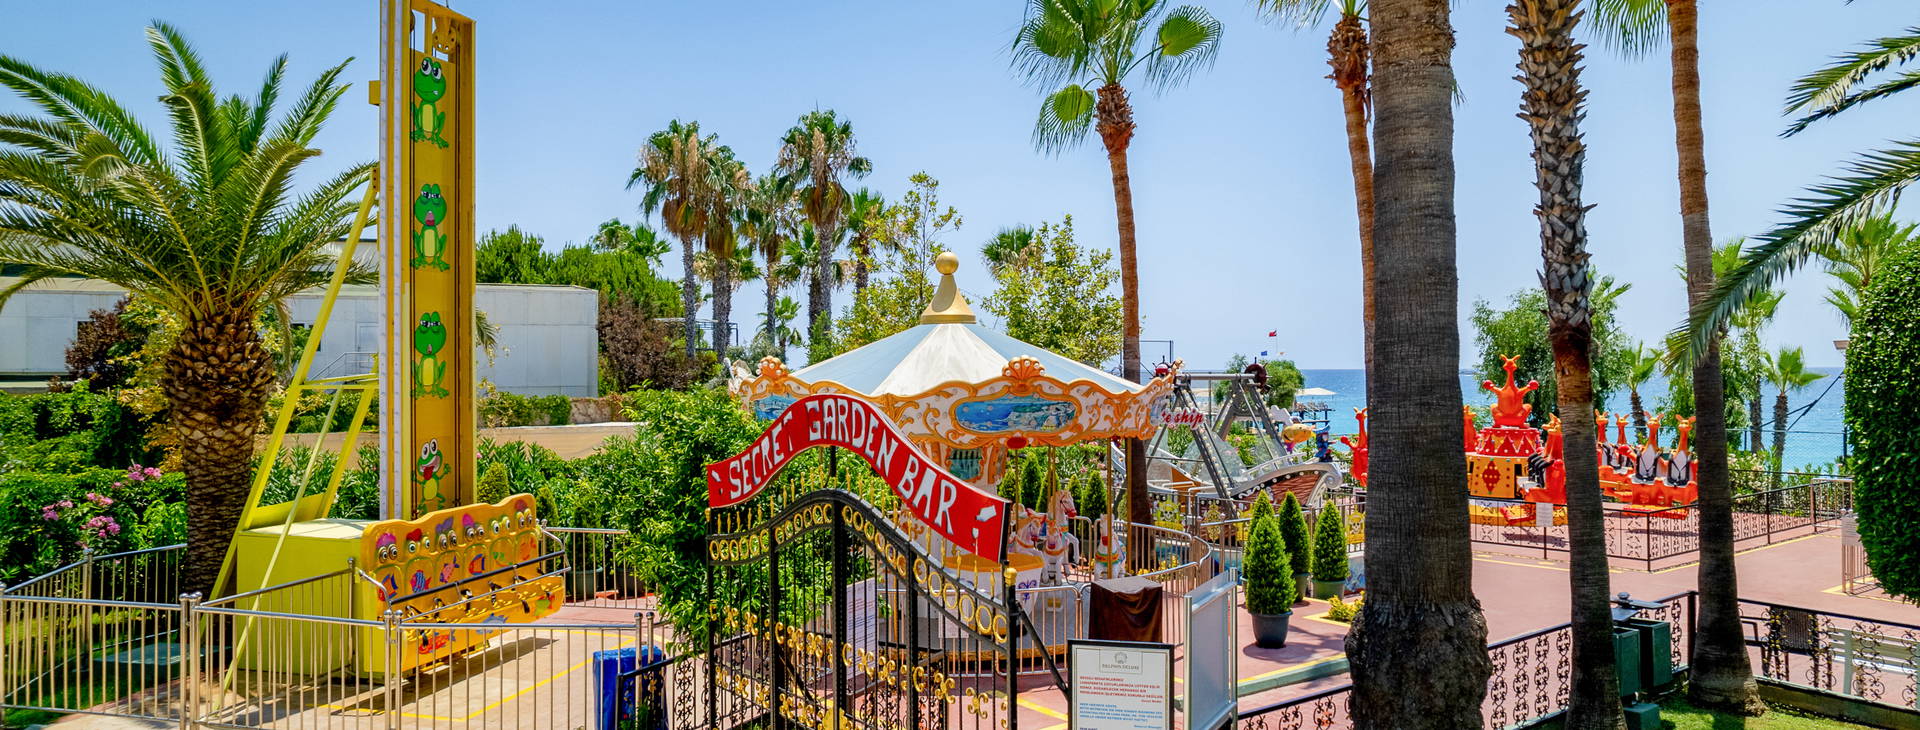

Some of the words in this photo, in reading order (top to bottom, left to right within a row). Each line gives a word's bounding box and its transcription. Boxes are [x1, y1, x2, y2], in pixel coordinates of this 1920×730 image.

[1174, 407, 1204, 429] ship
[728, 411, 793, 500] SECRET
[805, 398, 898, 477] GARDEN
[898, 453, 957, 535] BAR
